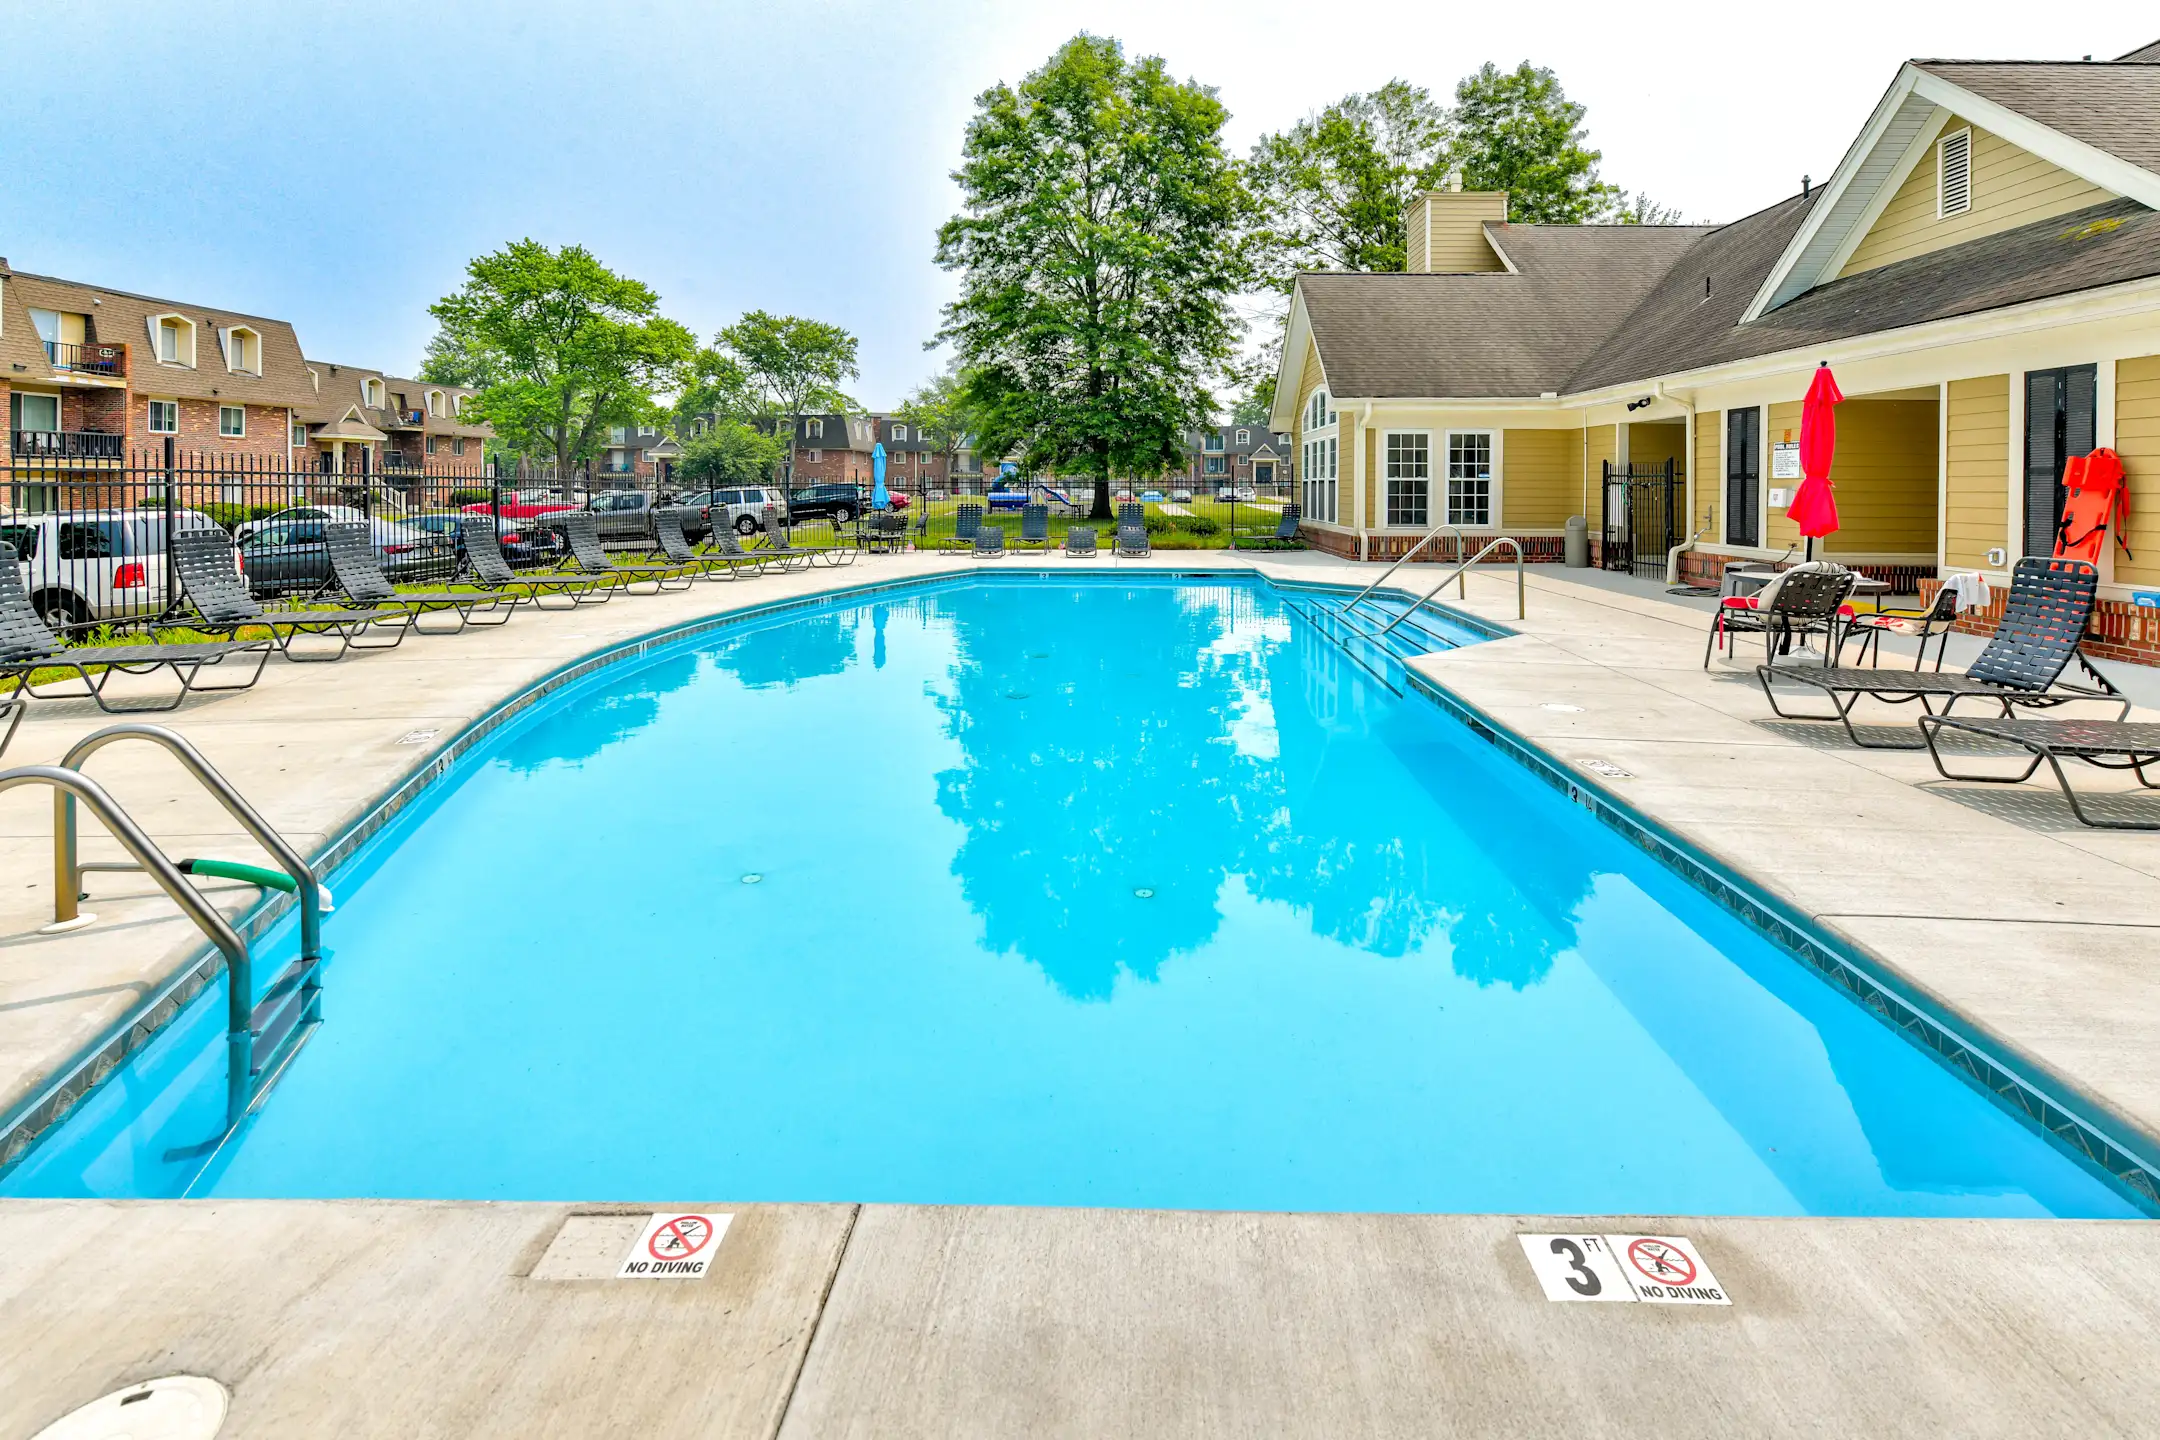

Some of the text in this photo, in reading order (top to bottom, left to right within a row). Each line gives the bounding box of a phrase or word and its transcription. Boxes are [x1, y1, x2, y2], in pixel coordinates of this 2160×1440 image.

[1571, 786, 1578, 804] 3
[625, 1262, 704, 1274] NO DIVING
[1549, 1238, 1602, 1297] 3 FT
[1639, 1285, 1723, 1301] NO DIVING
